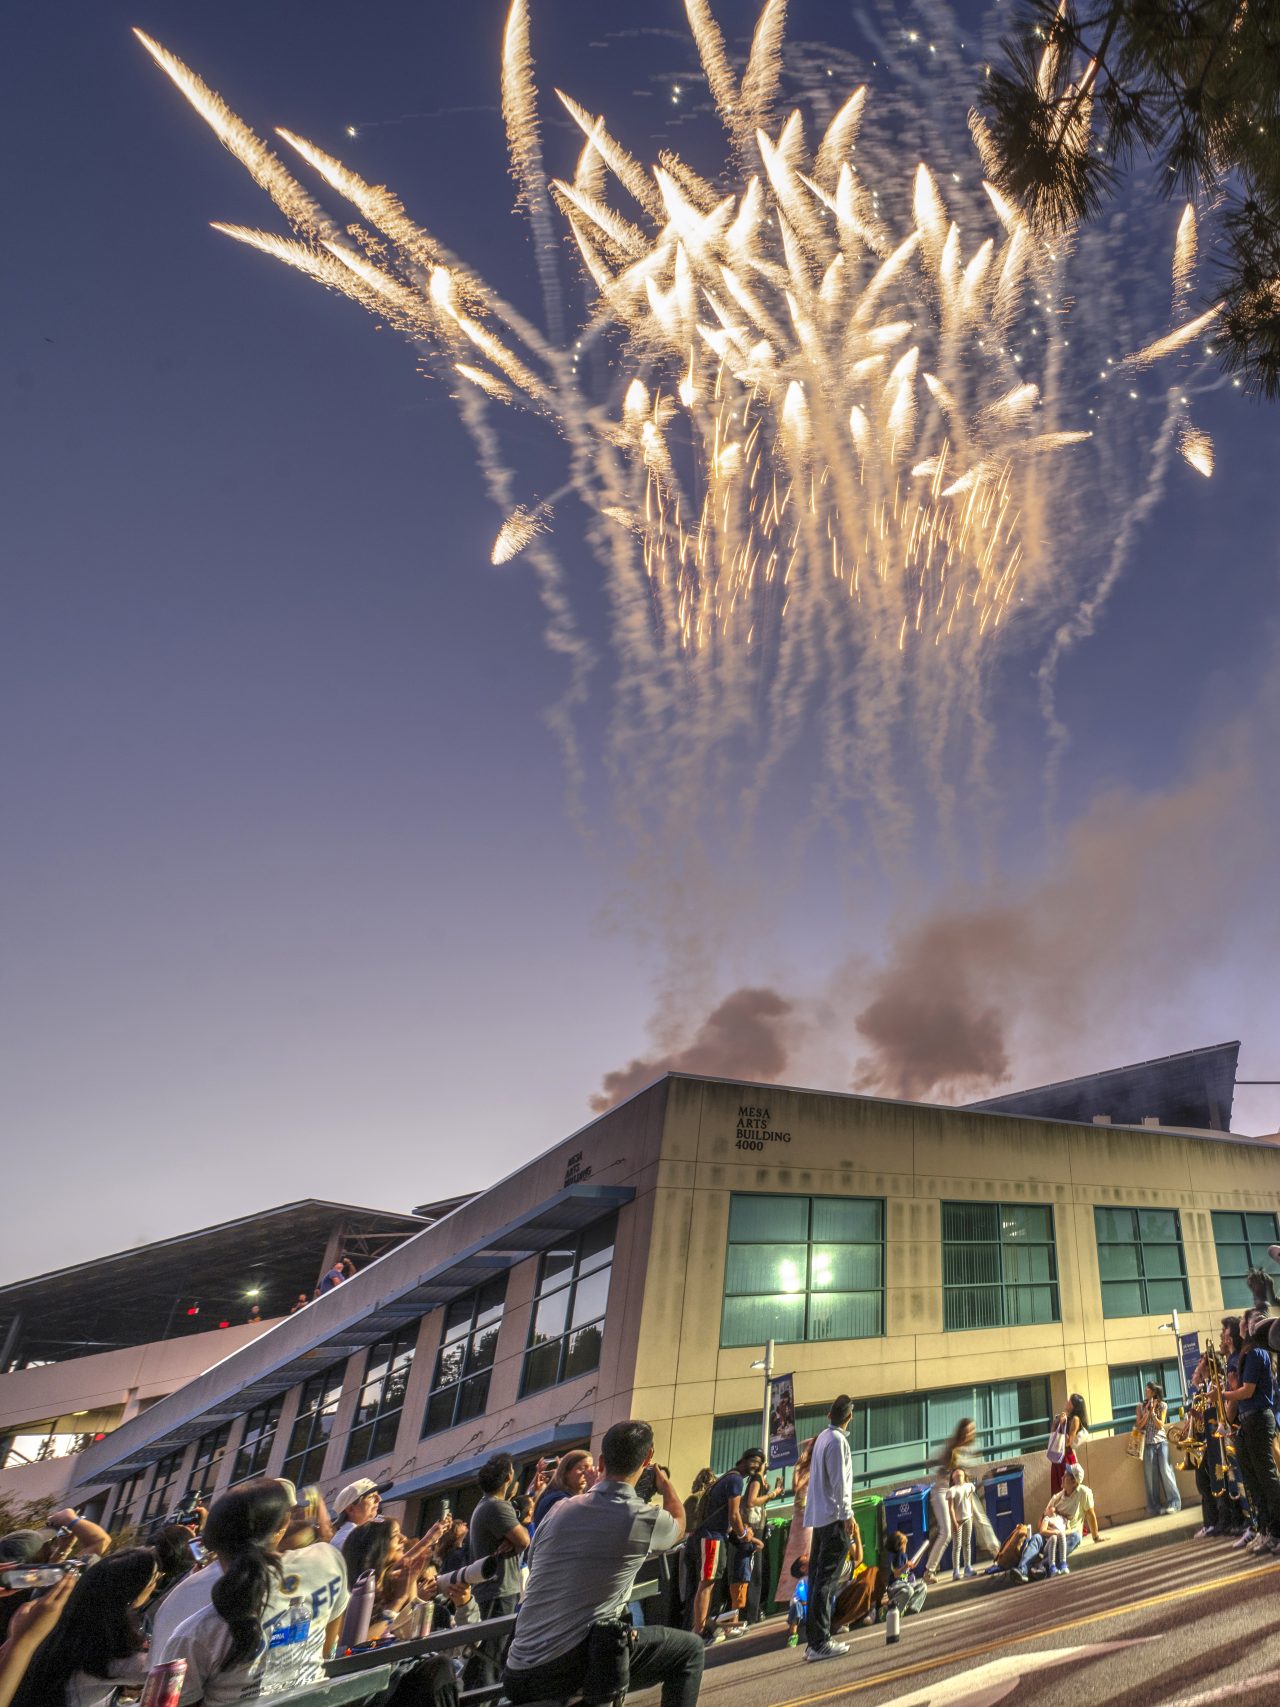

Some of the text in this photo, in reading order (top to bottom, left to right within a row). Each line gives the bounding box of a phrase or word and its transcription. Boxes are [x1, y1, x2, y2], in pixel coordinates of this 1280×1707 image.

[738, 1106, 770, 1119] MESA
[736, 1118, 767, 1129] ARTS
[736, 1129, 791, 1142] BUILDING
[735, 1140, 763, 1151] 4000
